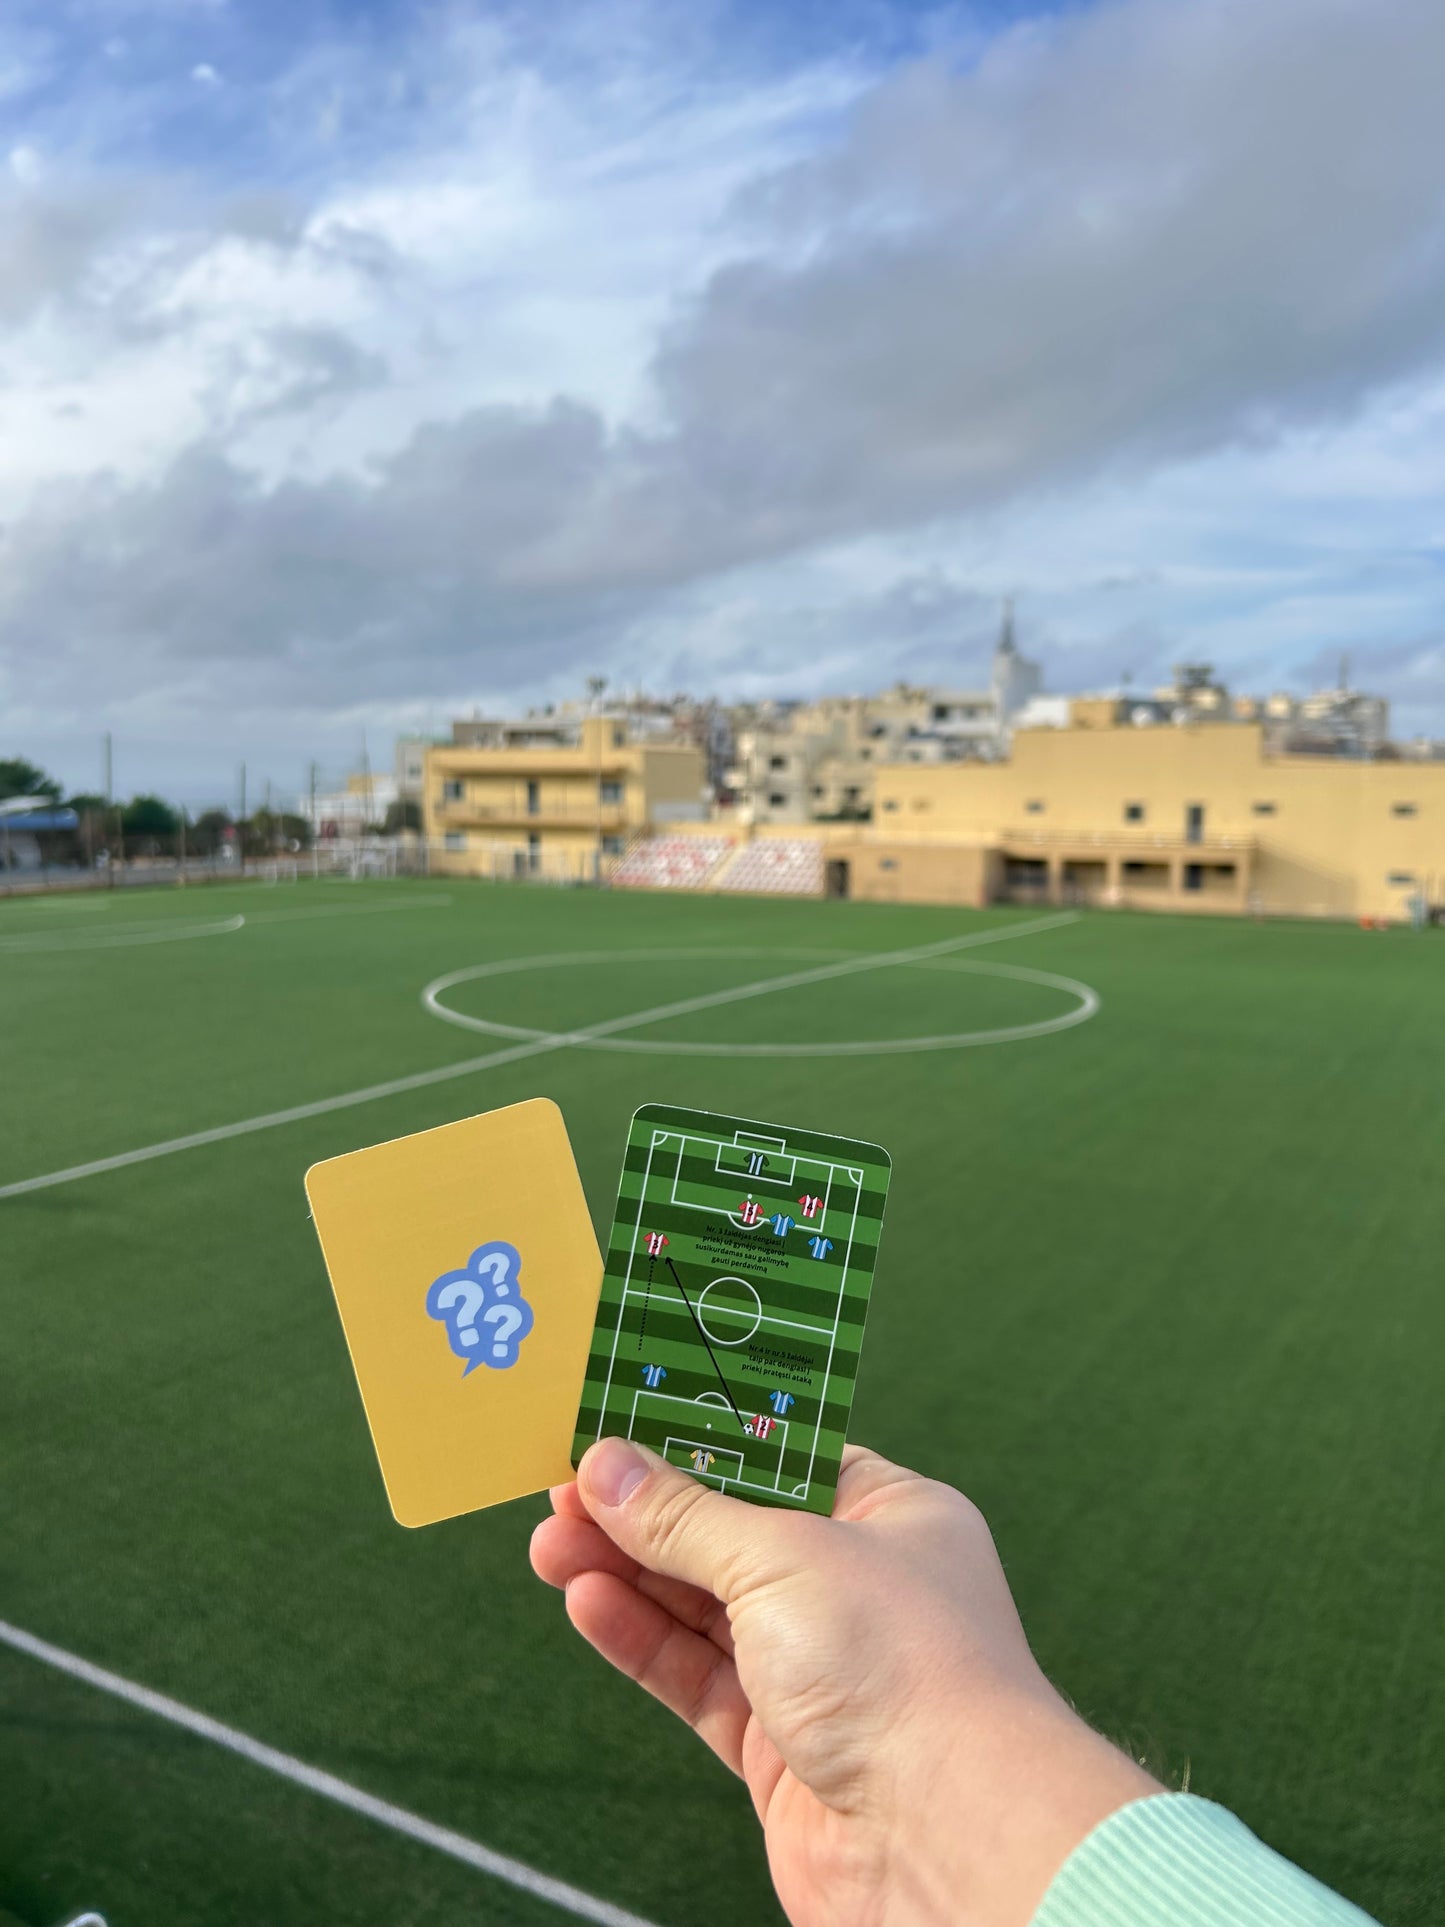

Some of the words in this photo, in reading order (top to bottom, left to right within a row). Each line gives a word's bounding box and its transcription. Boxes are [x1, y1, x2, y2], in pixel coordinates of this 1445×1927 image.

[747, 1205, 754, 1217] 5
[806, 1201, 813, 1213] 4
[706, 1225, 717, 1233] Nr.
[652, 1238, 659, 1250] 3
[764, 1358, 776, 1366] pat
[760, 1420, 767, 1431] 2
[700, 1455, 706, 1465] 1
